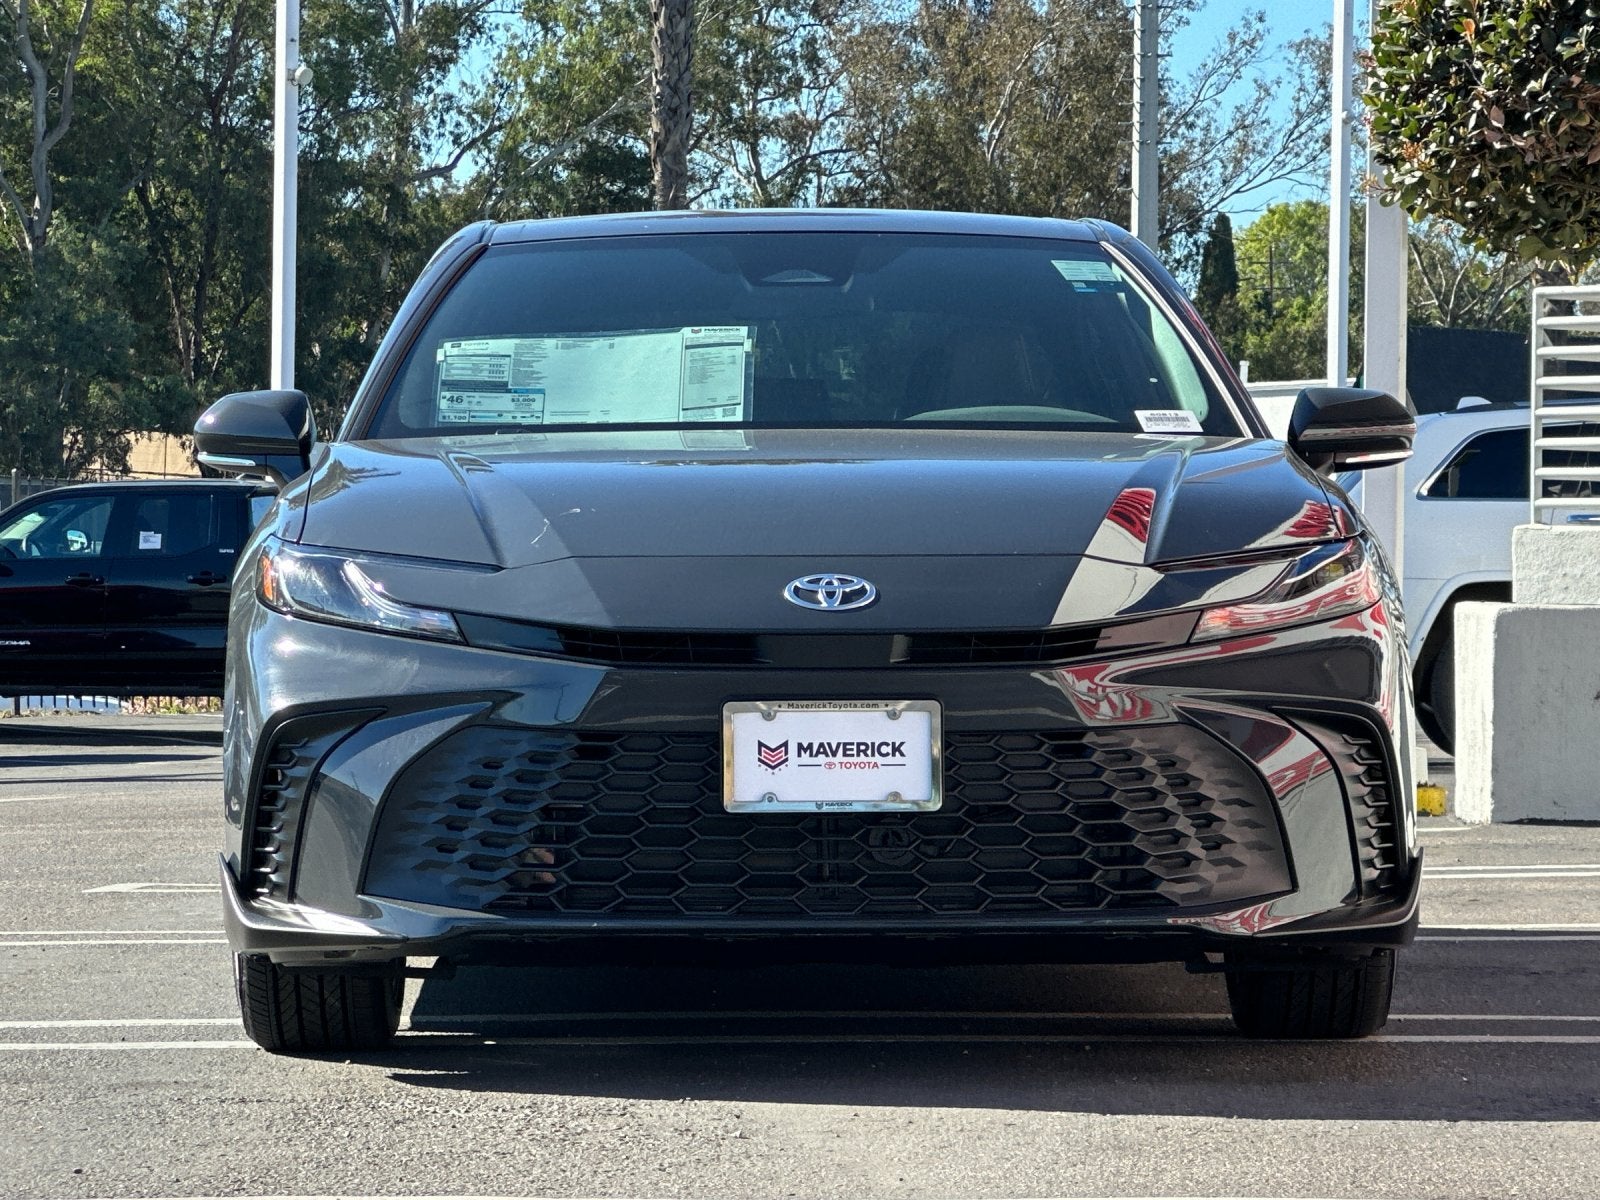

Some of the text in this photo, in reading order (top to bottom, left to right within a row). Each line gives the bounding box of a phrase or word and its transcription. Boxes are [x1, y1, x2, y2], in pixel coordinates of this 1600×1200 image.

[446, 395, 464, 405] 46
[787, 701, 880, 711] MaverickToyota.com
[797, 741, 906, 758] MAVERICK
[838, 761, 879, 770] TOYOTA
